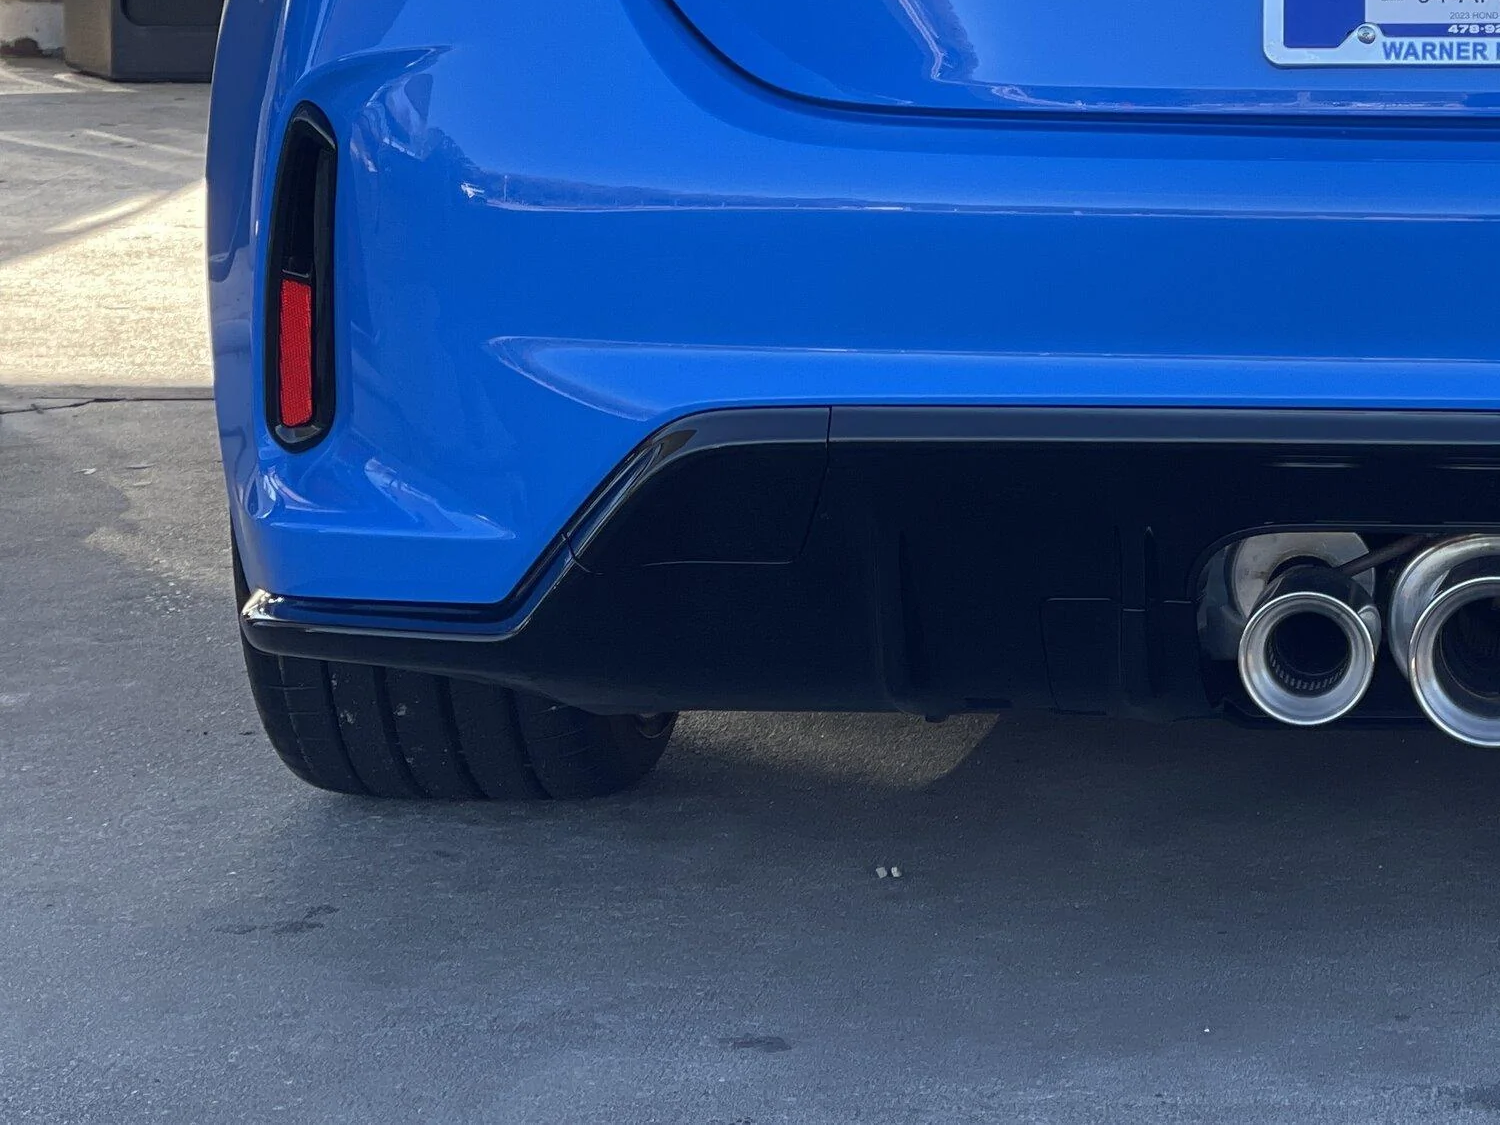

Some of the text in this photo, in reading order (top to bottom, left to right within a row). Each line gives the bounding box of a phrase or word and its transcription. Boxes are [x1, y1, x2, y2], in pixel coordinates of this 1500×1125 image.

[1449, 11, 1470, 20] 2023
[1472, 11, 1499, 20] HOND
[1382, 41, 1489, 61] WARNER
